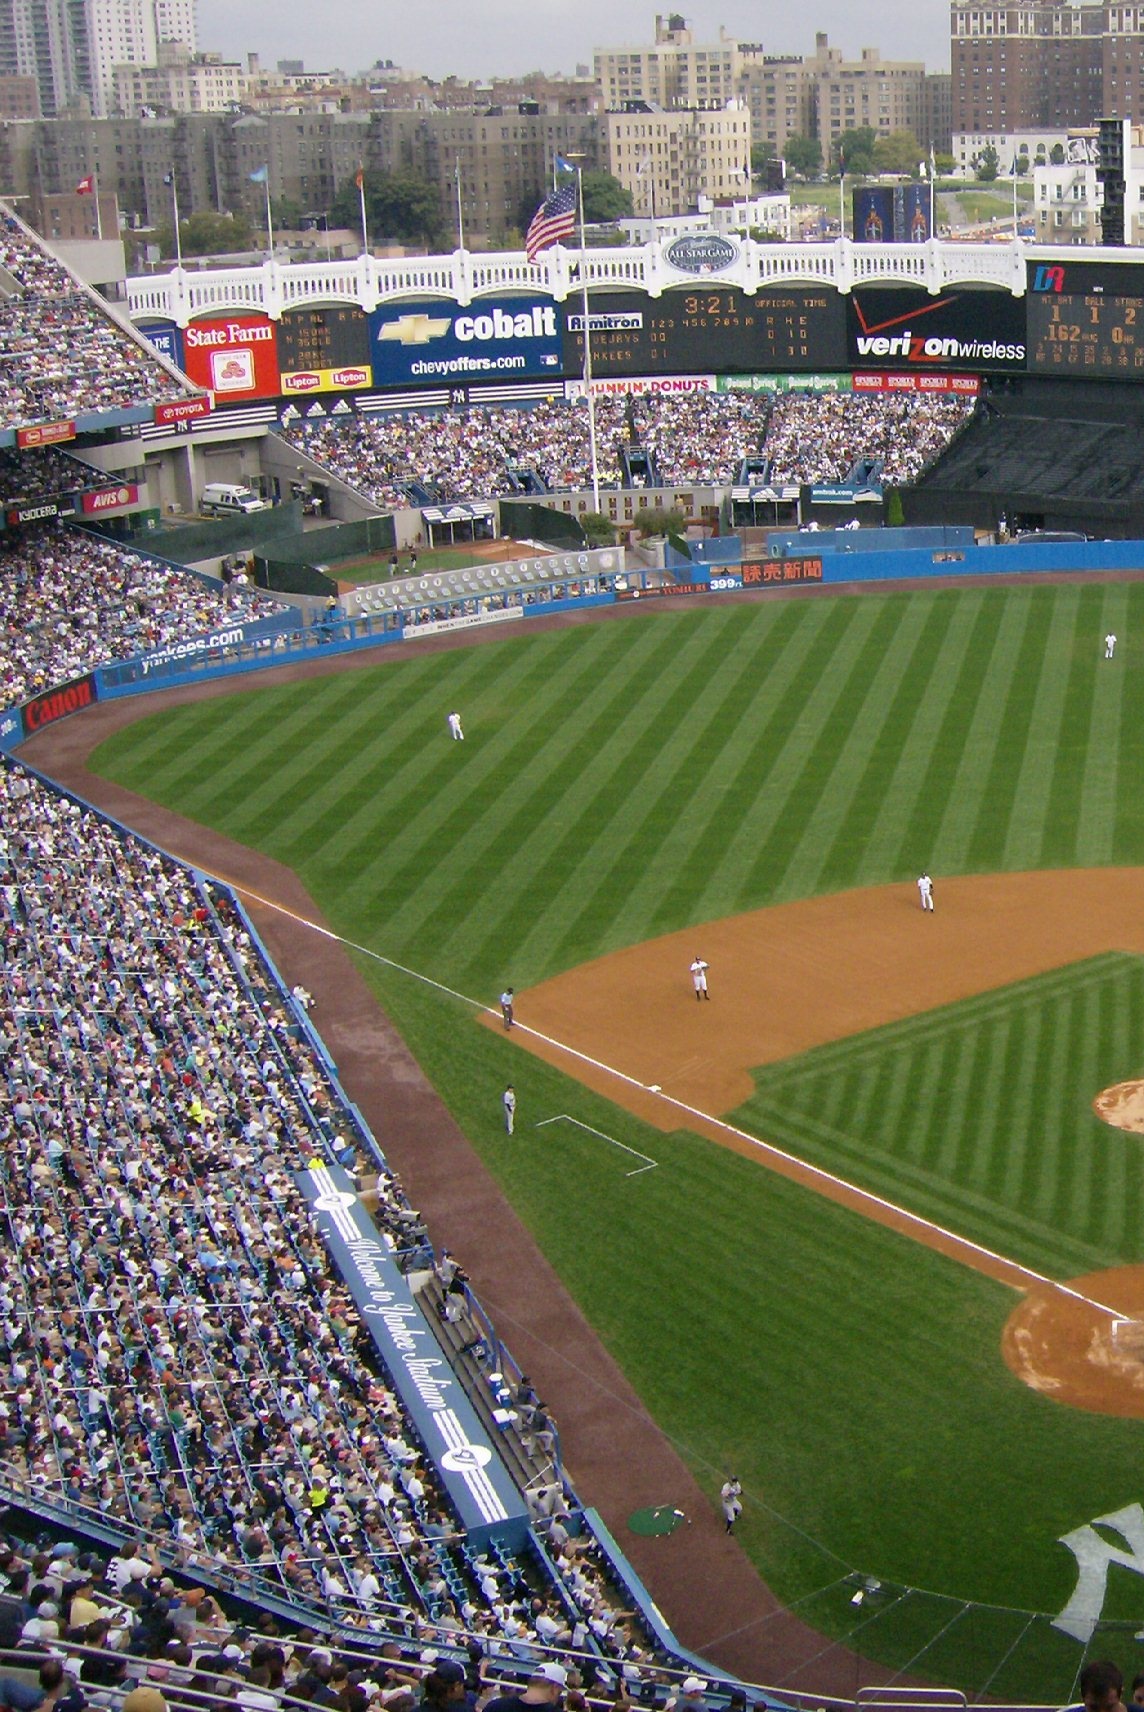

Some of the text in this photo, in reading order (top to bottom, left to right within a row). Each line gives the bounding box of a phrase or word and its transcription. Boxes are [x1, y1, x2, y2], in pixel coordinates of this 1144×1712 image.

[684, 296, 737, 314] 3:21
[754, 299, 827, 308] OFFICIAL TIME
[800, 316, 807, 325] E
[1051, 305, 1061, 322] 1
[1090, 306, 1100, 324] 1
[1124, 308, 1136, 325] 2
[454, 307, 557, 342] cobalt
[571, 315, 640, 330] Armitron
[187, 325, 272, 347] State Farm
[577, 333, 639, 345] BUEJAYS
[1043, 324, 1081, 342] .162
[1111, 326, 1124, 344] 0
[155, 336, 169, 349] THE
[411, 356, 525, 375] chevyoffers.com
[286, 379, 318, 388] Lipton
[334, 374, 366, 384] Lipton
[651, 380, 708, 392] DONUTS
[173, 403, 204, 416] TOYOTA
[93, 492, 117, 507] AVIS
[710, 578, 736, 590] 399
[141, 627, 244, 674] yankees.com
[25, 681, 92, 731] Canon
[347, 1238, 453, 1411] Welcome to Yankee Stadium
